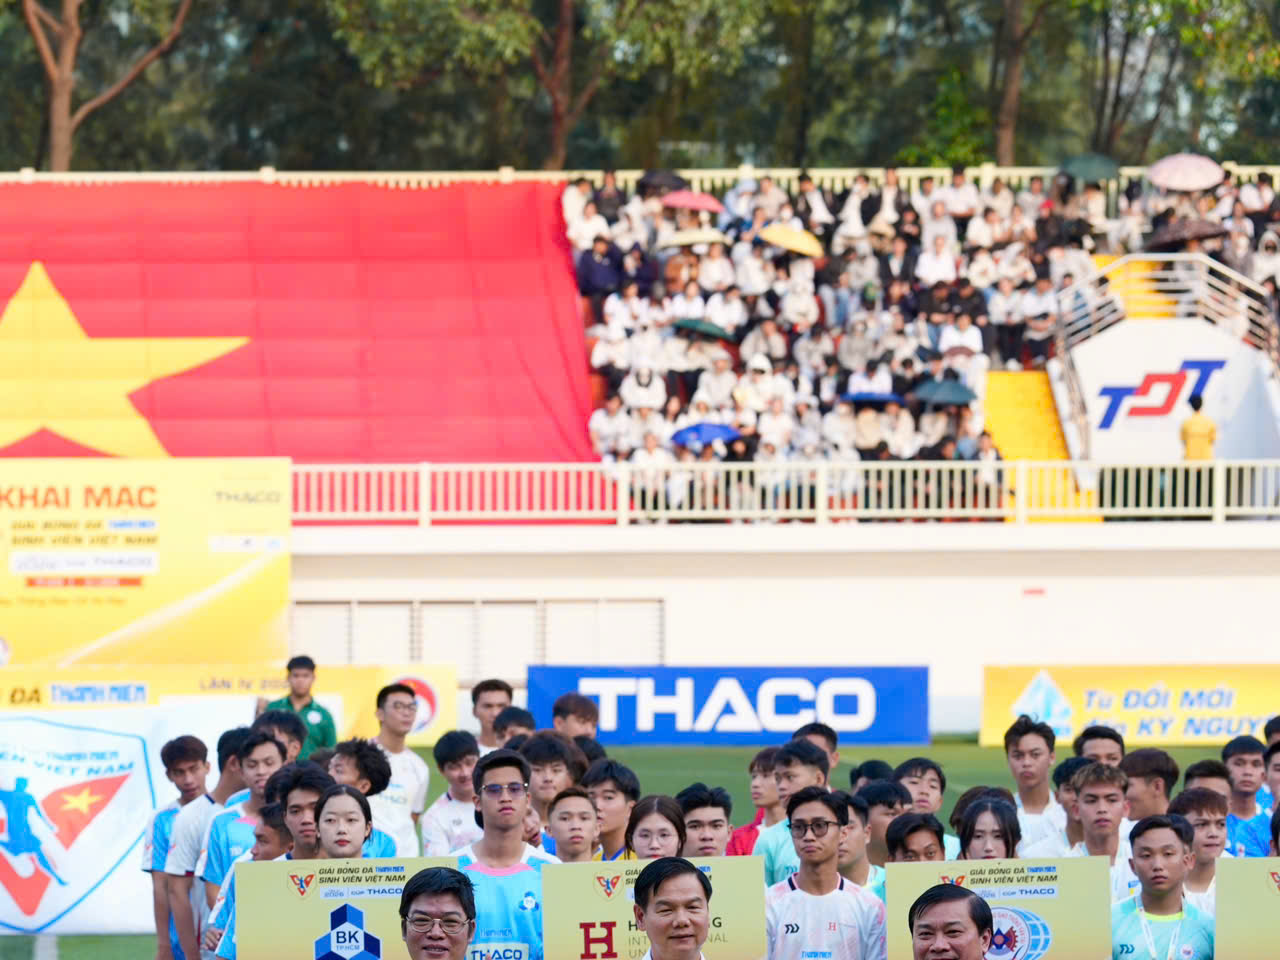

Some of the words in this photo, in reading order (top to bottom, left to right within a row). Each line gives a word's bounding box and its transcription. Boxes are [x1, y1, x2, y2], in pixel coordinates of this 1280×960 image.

[578, 677, 876, 732] THACO
[319, 867, 335, 875] GIẢI
[337, 866, 360, 874] BÓNG
[988, 866, 1011, 874] BÓNG
[318, 876, 340, 884] SINH
[343, 875, 362, 883] VIÊN
[365, 874, 383, 883] VIỆT
[384, 874, 406, 882] NAM
[970, 877, 992, 885] SINH
[994, 875, 1014, 883] VIÊN
[1016, 875, 1034, 884] VIỆT
[1036, 874, 1058, 882] NAM
[1018, 888, 1055, 896] THACO
[336, 930, 359, 944] BK
[579, 921, 618, 960] H
[471, 948, 523, 960] THACO
